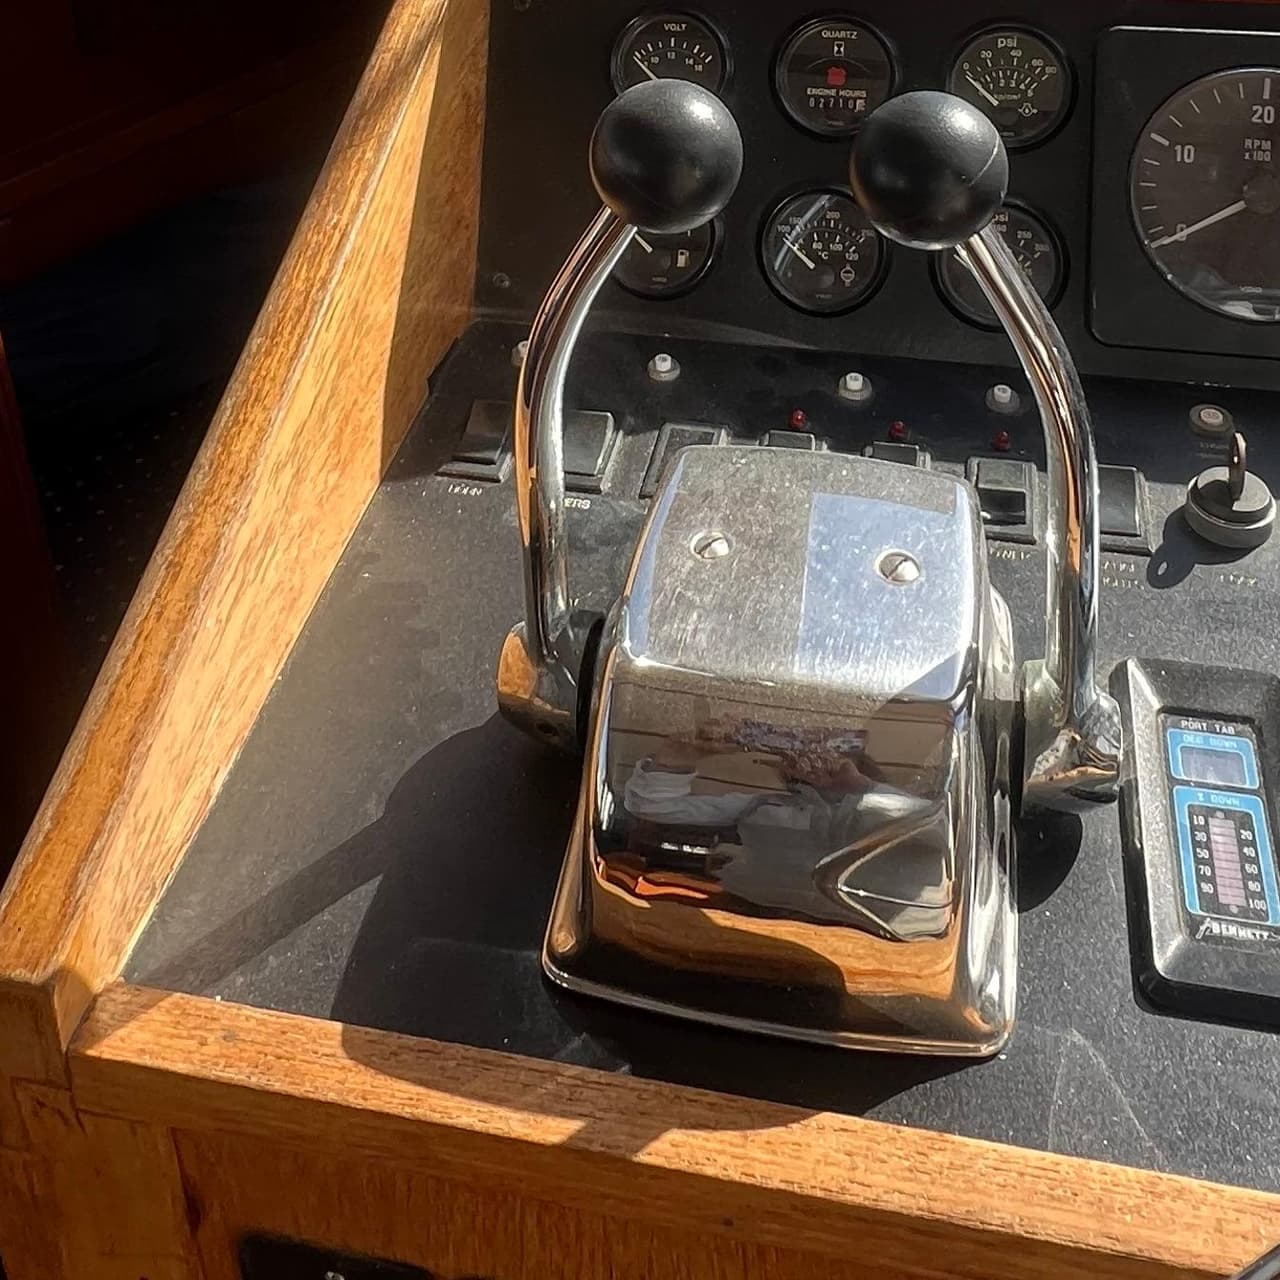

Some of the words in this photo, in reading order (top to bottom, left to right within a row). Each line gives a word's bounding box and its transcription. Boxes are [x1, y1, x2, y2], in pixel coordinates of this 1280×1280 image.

[663, 23, 688, 32] VOLT
[821, 29, 859, 40] QUARTZ
[997, 36, 1018, 48] psi
[806, 87, 837, 97] ENGINE
[838, 89, 867, 98] HOURS
[1251, 104, 1276, 124] 20
[1243, 138, 1272, 150] RPM
[1174, 144, 1195, 163] 10
[1181, 720, 1208, 731] PORT
[1214, 723, 1236, 735] TAB
[1210, 793, 1241, 807] DOWN
[1192, 814, 1205, 826] 10
[1194, 831, 1207, 842] 30
[1239, 828, 1253, 841] 20
[1196, 847, 1209, 859] 50
[1242, 846, 1256, 858] 40
[1197, 864, 1212, 877] 70
[1244, 863, 1258, 875] 60
[1200, 881, 1214, 894] 90
[1247, 880, 1261, 893] 80
[1249, 899, 1267, 912] 100
[1211, 922, 1270, 940] BENNETT
